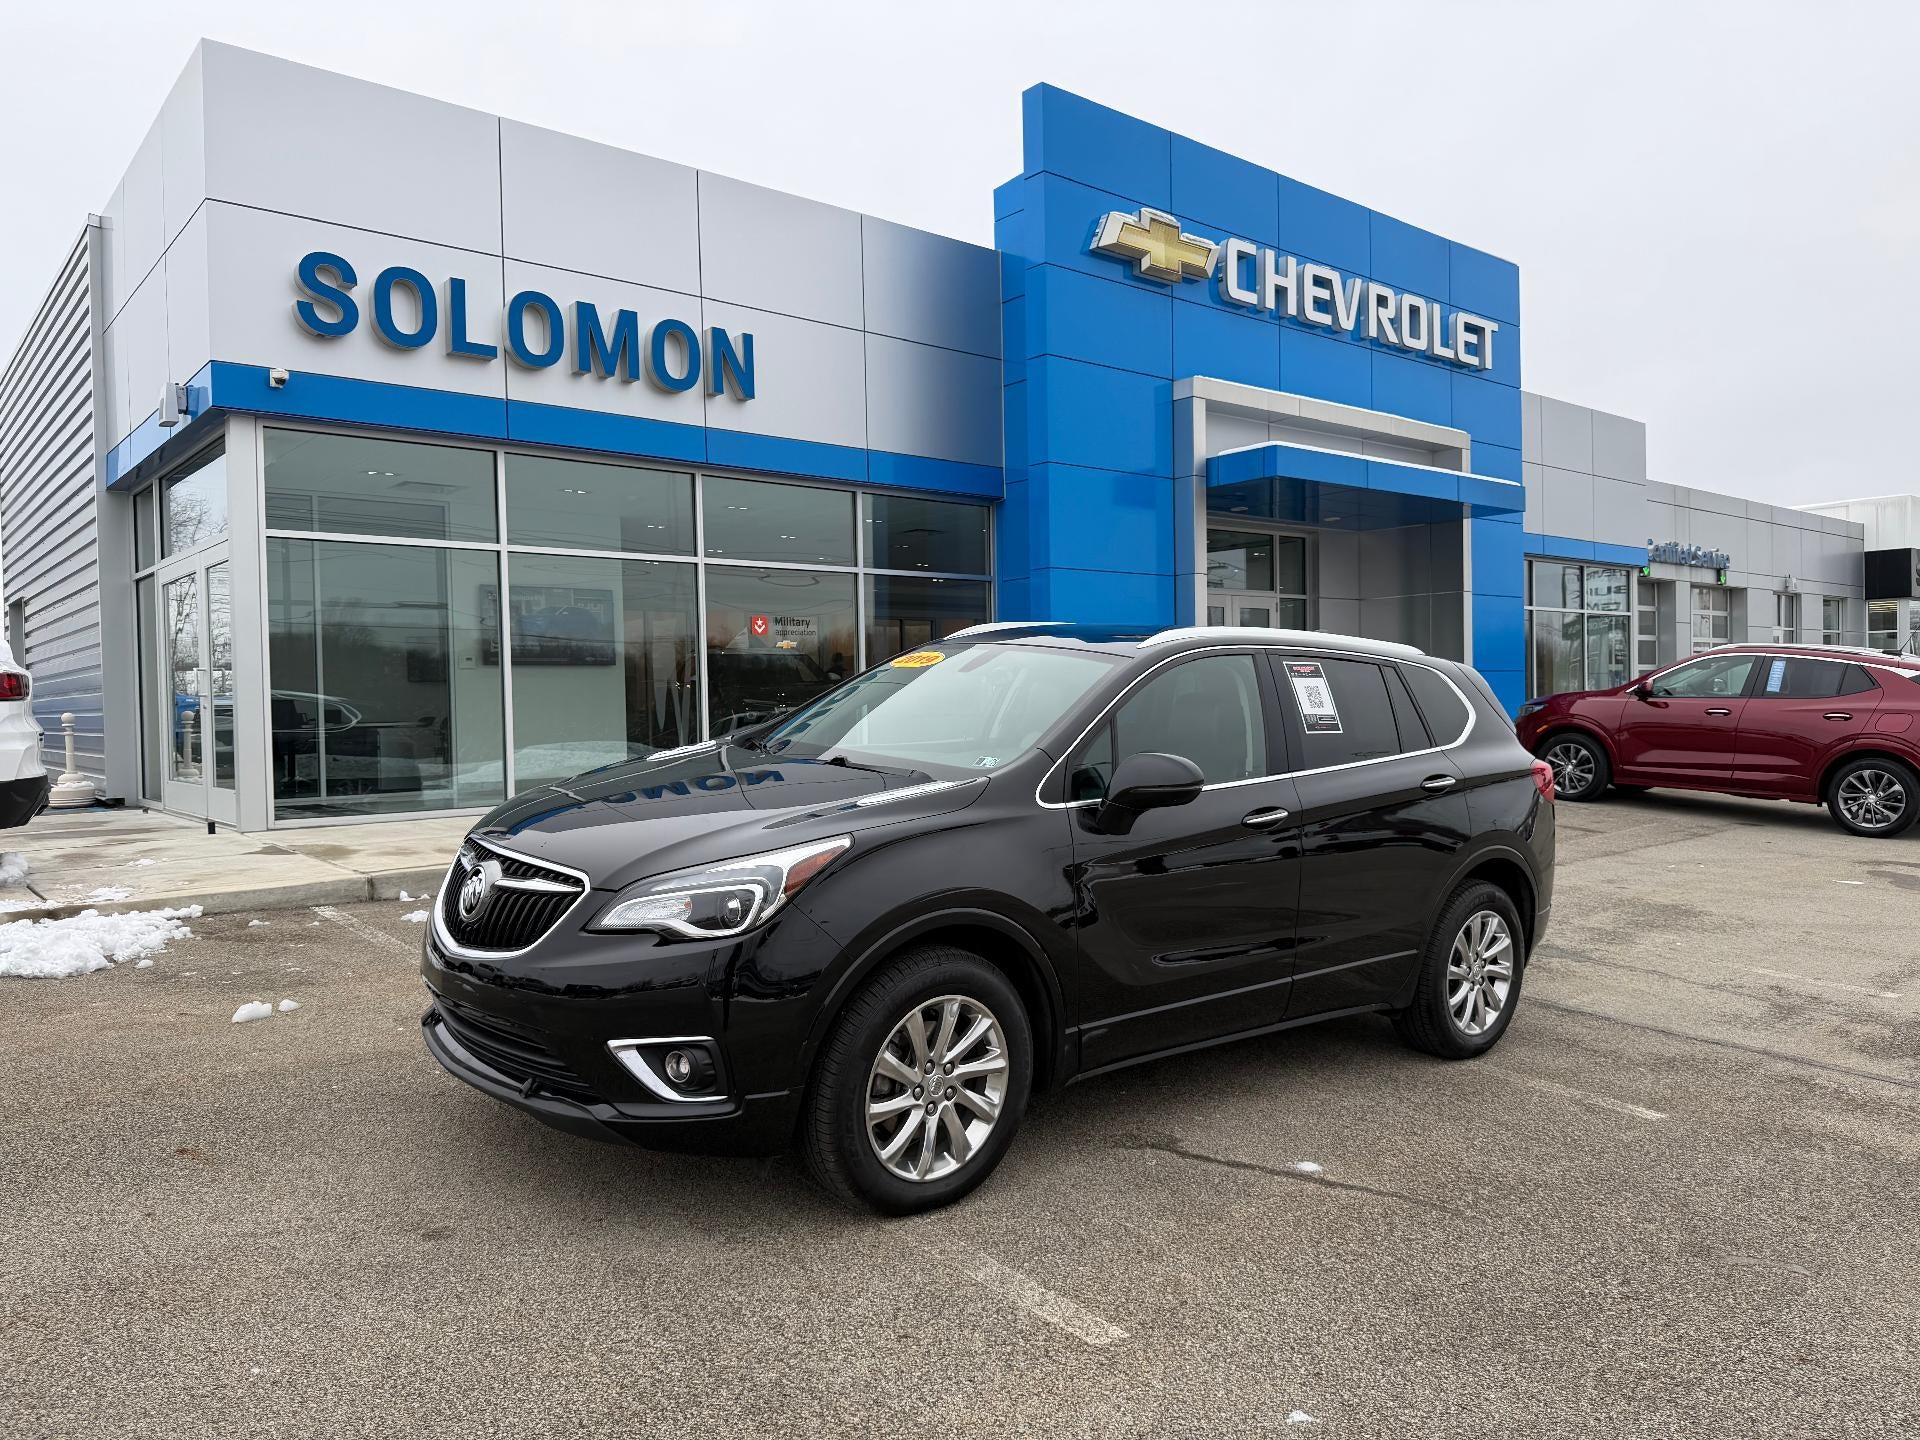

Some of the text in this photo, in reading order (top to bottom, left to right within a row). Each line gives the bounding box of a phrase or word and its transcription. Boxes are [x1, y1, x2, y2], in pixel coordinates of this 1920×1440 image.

[292, 251, 756, 402] SOLOMON
[1217, 236, 1499, 371] CHEVROLET
[774, 616, 811, 629] Military
[775, 629, 817, 638] appreciation
